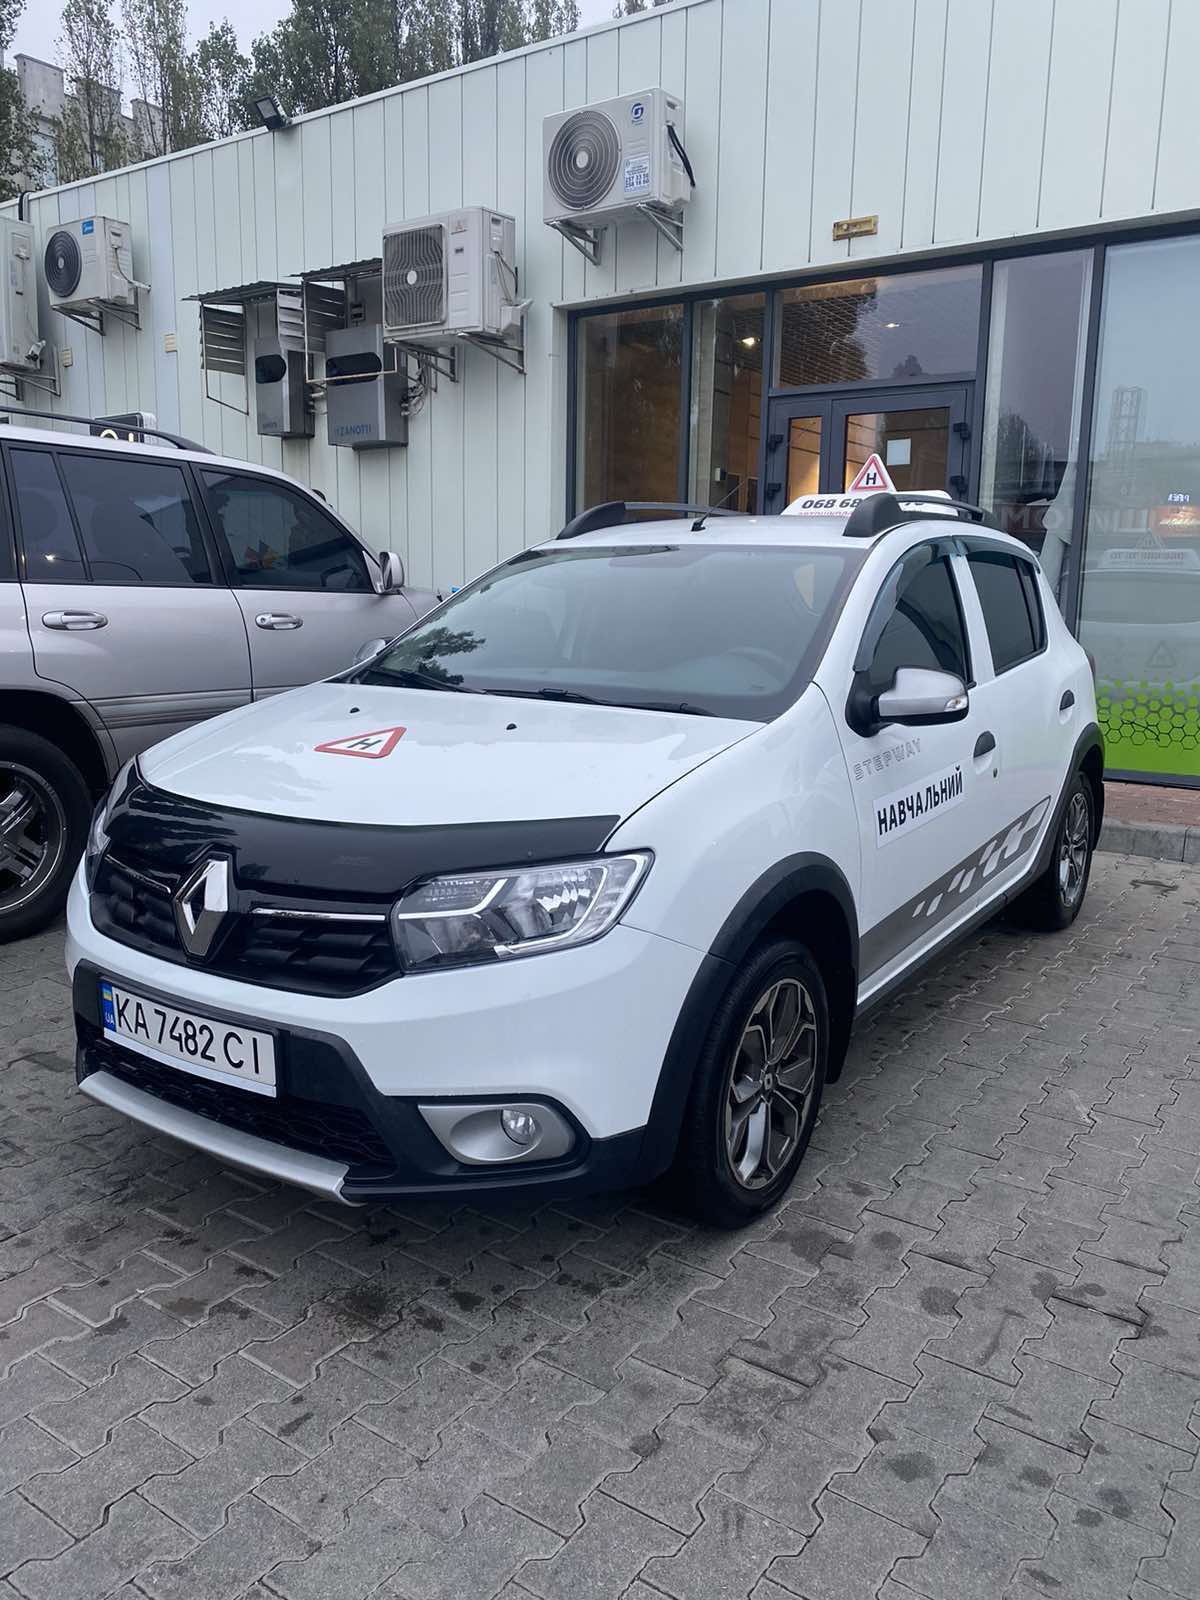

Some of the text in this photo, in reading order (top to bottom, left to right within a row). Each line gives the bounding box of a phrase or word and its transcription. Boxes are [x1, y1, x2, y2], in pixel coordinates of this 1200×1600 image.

[801, 499, 837, 509] 068
[853, 738, 921, 781] STEPWAY
[877, 764, 963, 836] НАВЧАЛЬНИЙ
[105, 1011, 115, 1025] UA
[154, 1008, 216, 1063] 7482
